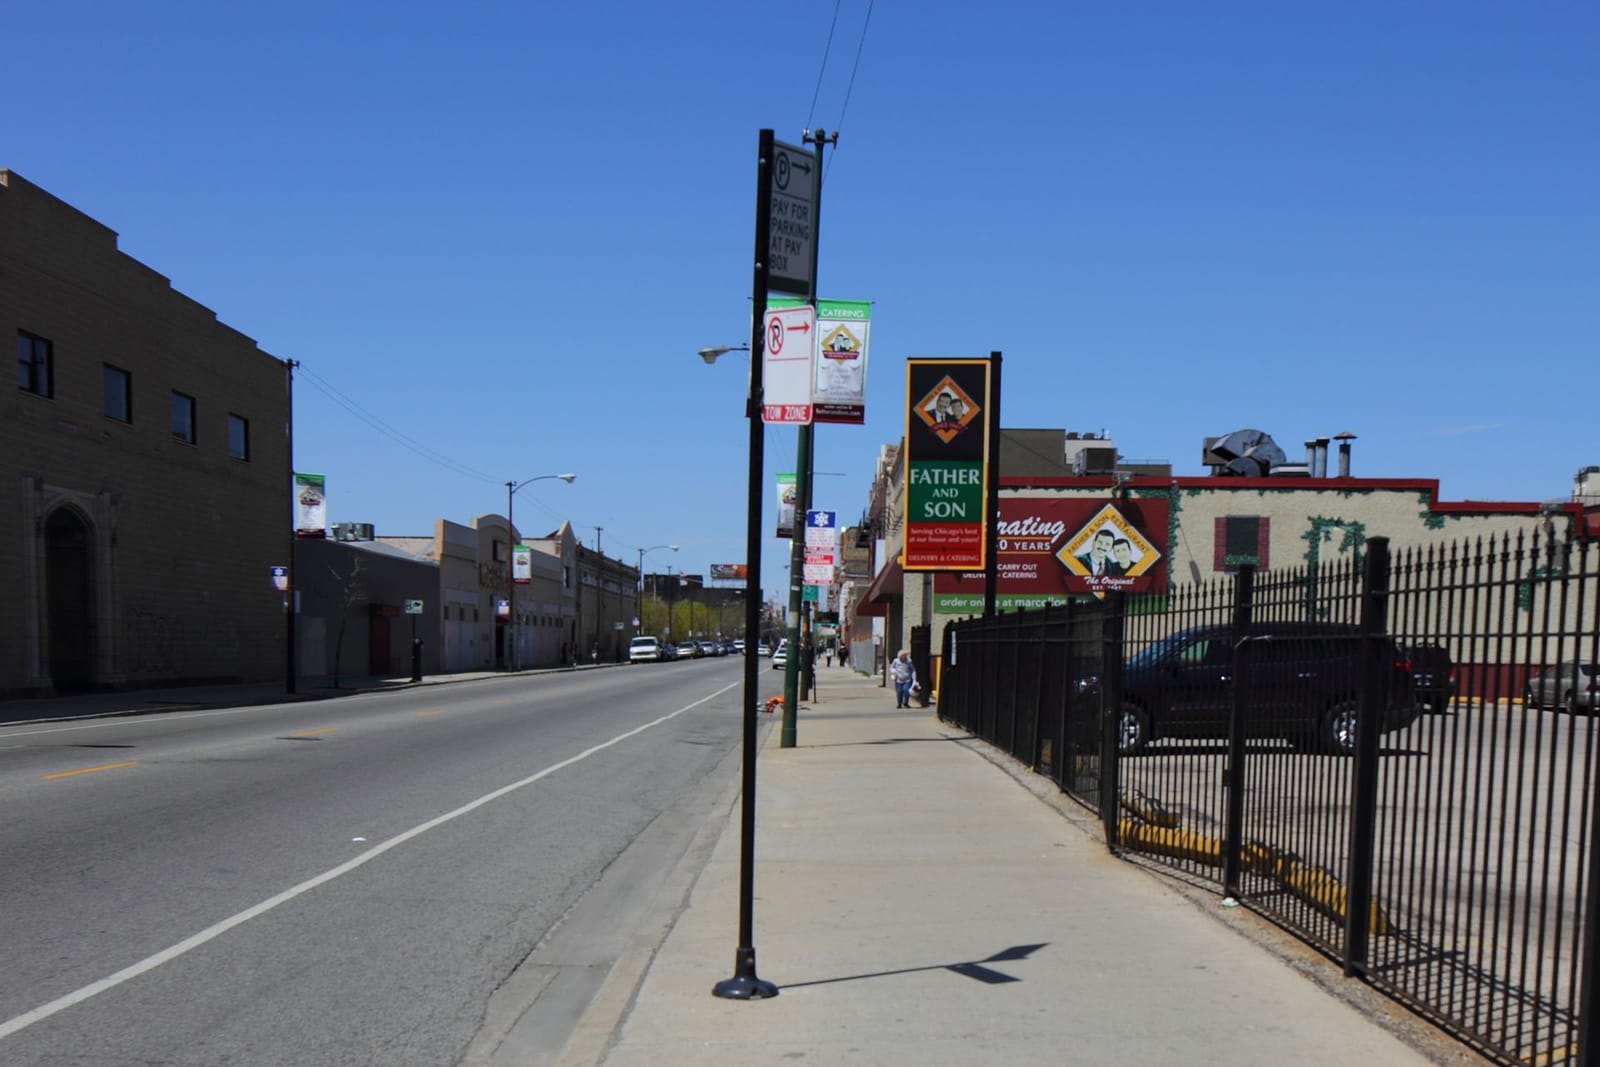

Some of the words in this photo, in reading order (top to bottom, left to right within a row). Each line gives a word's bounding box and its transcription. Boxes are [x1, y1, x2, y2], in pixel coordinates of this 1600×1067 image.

[772, 197, 789, 216] PAY
[792, 203, 809, 222] FOR
[771, 217, 810, 240] PARKING
[771, 235, 783, 252] AT
[785, 238, 802, 256] PAY
[770, 253, 788, 273] BOX
[821, 308, 864, 318] CATERING
[765, 406, 781, 421] TOW
[784, 405, 807, 420] ZONE
[910, 468, 980, 485] FATHER
[932, 488, 959, 498] AND
[924, 501, 966, 518] SON
[911, 528, 933, 536] Serving
[934, 528, 963, 536] Chicago's
[996, 510, 1066, 544] rating
[1112, 515, 1150, 552] RESTAURANT
[1014, 542, 1051, 550] YEARS
[1083, 576, 1099, 584] The
[1101, 576, 1135, 586] Original
[940, 597, 968, 607] order
[970, 597, 1000, 607] onle
[1002, 597, 1012, 607] at
